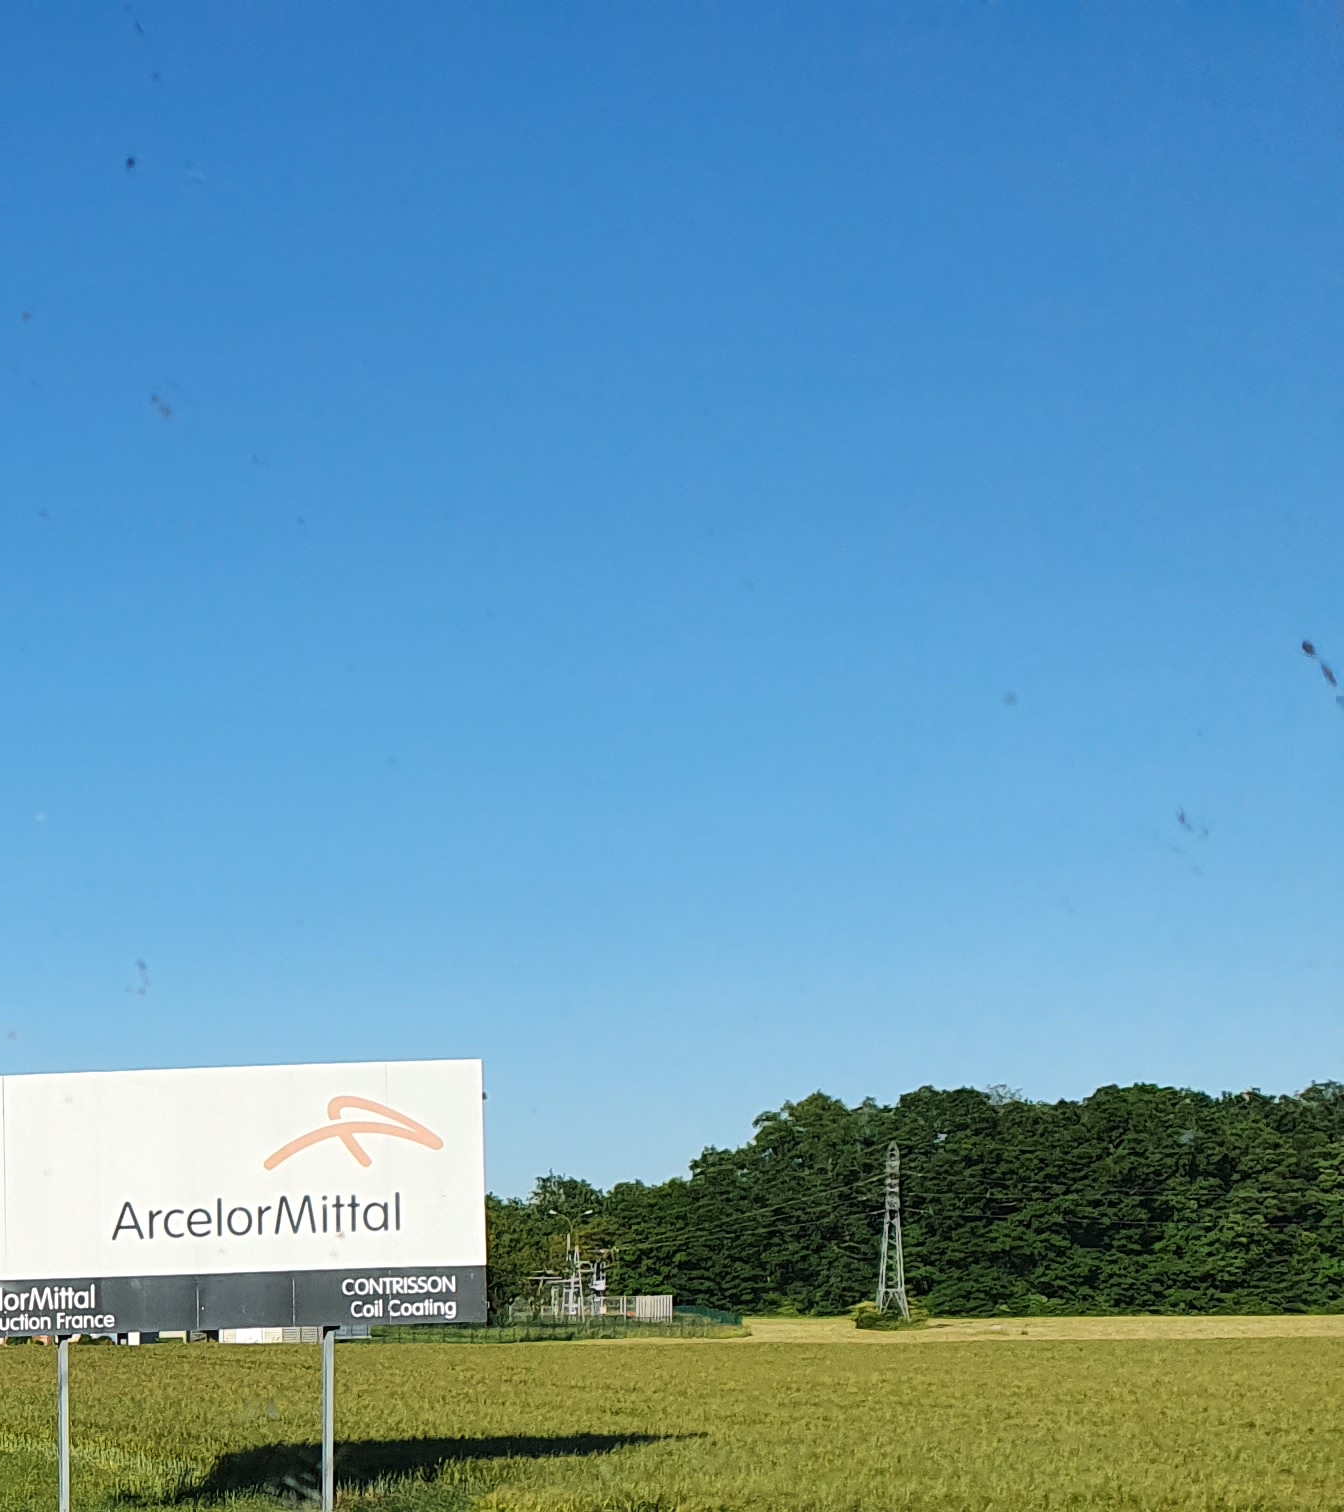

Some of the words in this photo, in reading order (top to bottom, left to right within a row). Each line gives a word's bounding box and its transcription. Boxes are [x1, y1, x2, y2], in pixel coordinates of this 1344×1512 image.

[111, 1191, 401, 1241] ArcelorMittal
[341, 1275, 457, 1296] CONTRISSON
[350, 1298, 384, 1318] Coil
[388, 1298, 457, 1320] Coating
[56, 1312, 116, 1330] France
